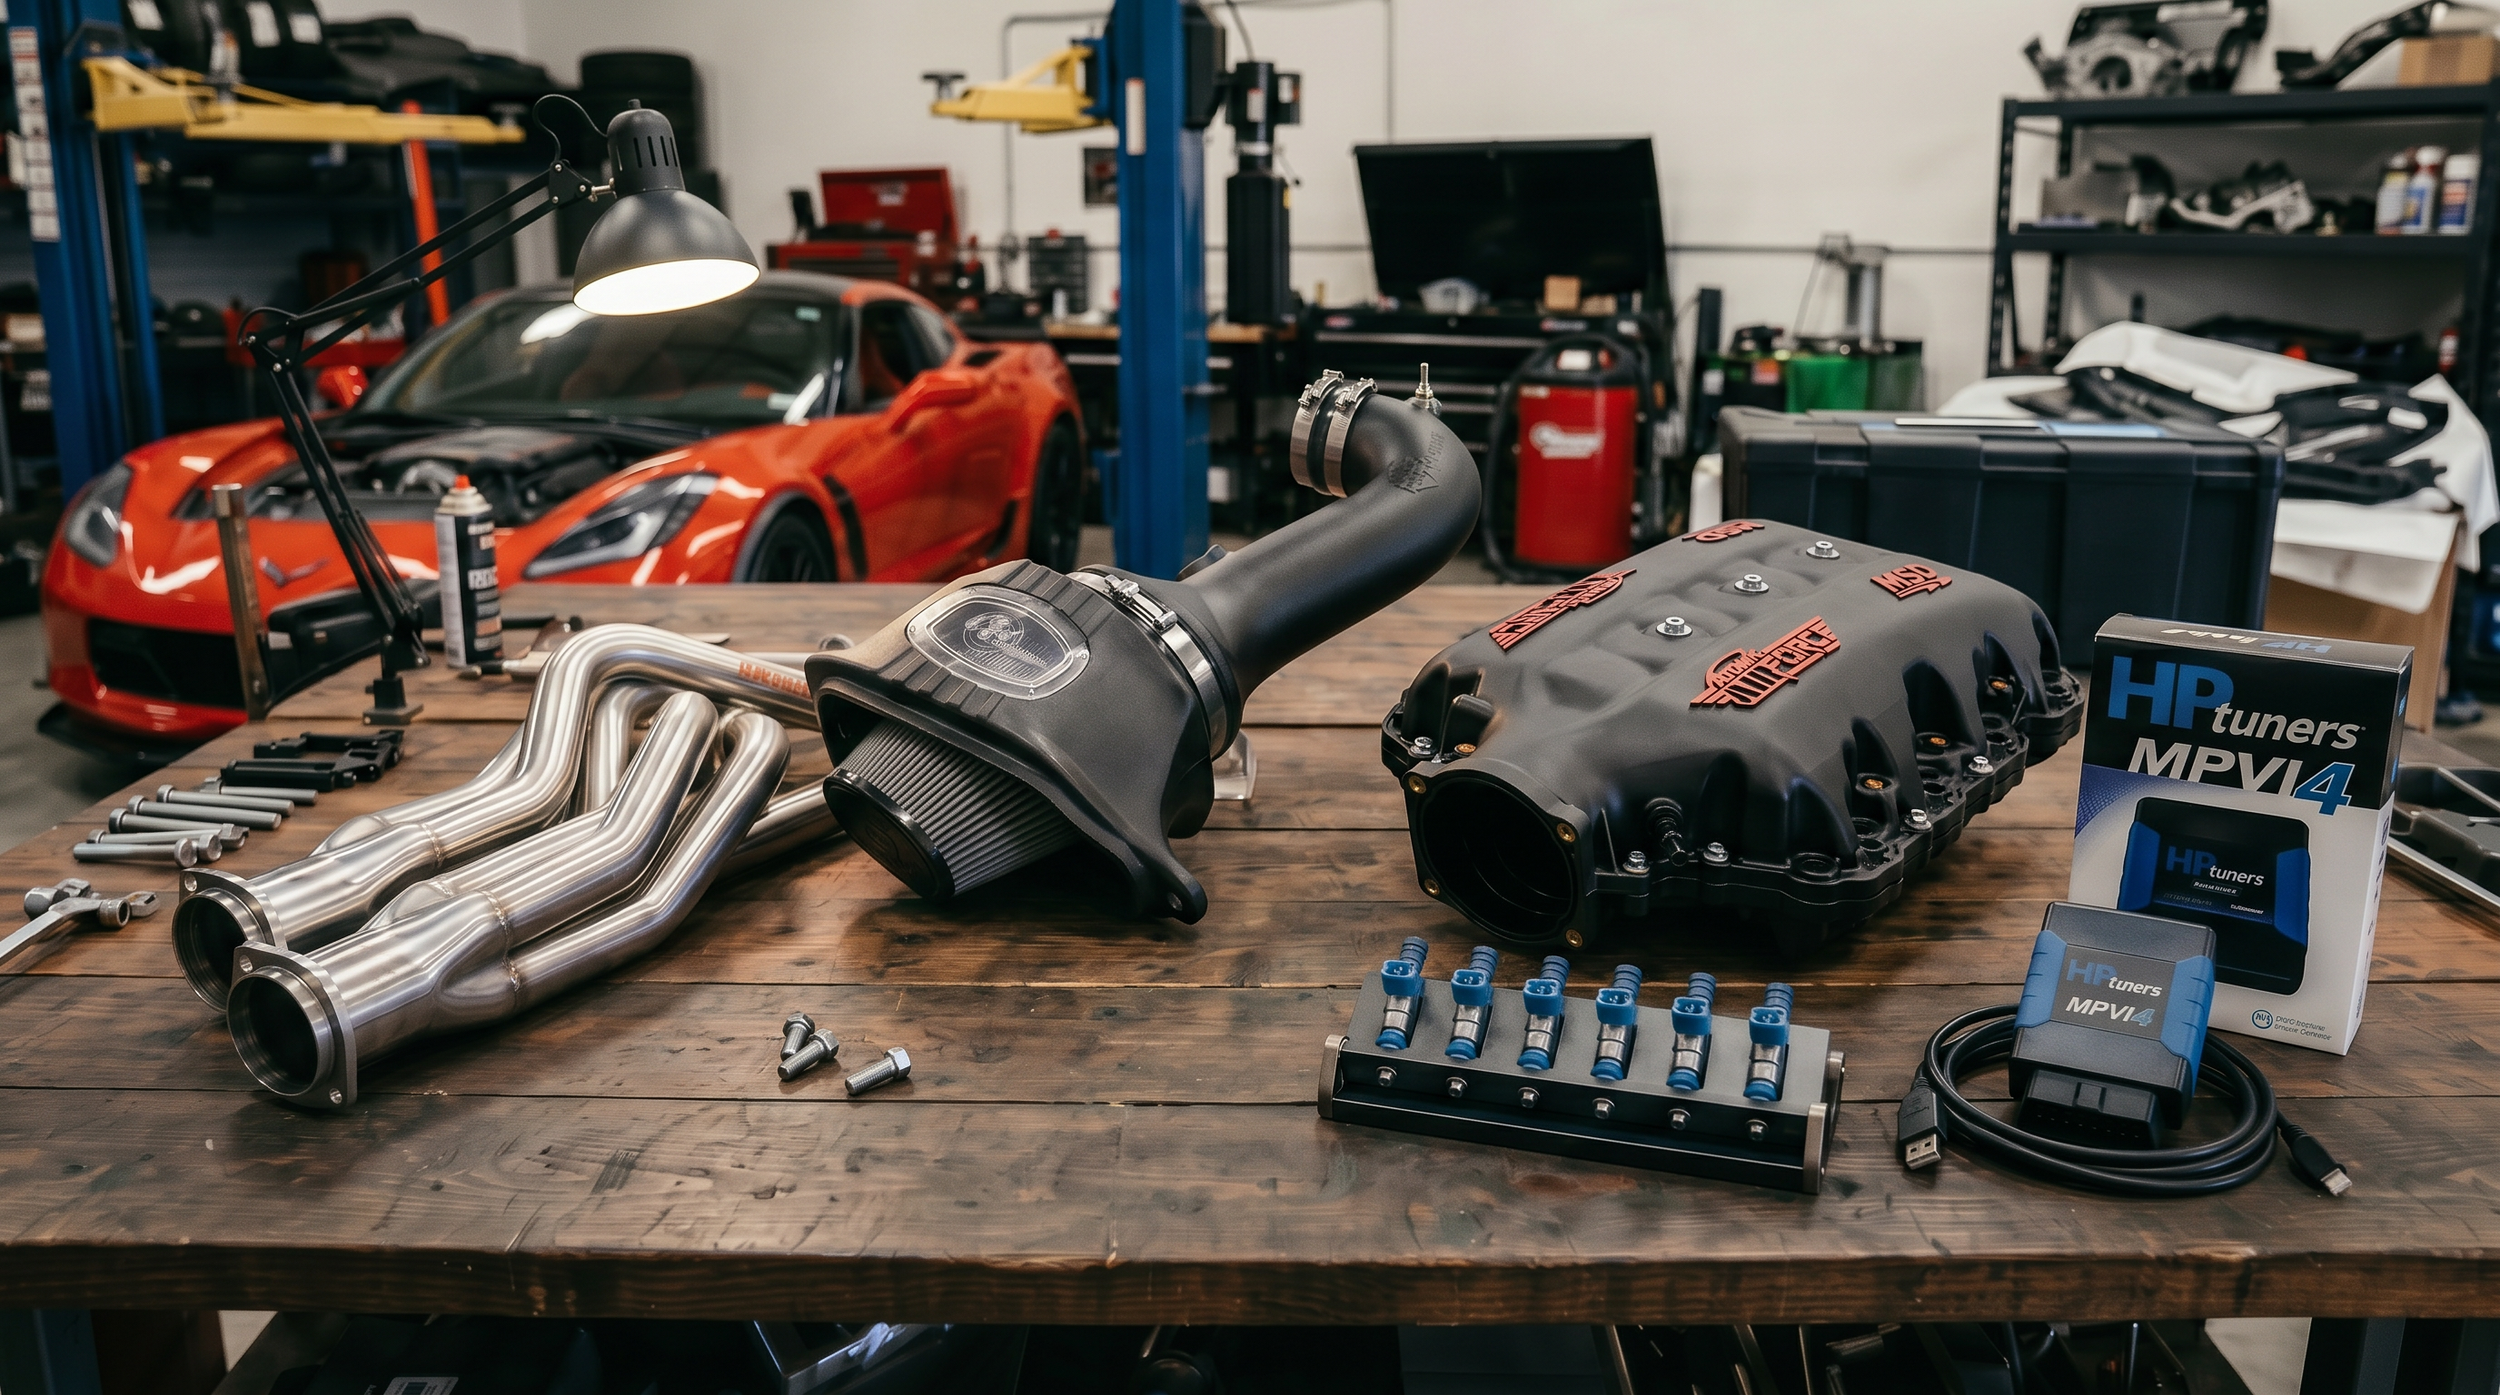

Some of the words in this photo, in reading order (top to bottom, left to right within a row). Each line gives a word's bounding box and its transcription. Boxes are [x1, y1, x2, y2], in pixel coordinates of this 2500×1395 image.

[1870, 564, 1938, 593] MSD
[2108, 655, 2234, 730] HP
[2211, 702, 2360, 750] tuners
[2127, 737, 2356, 816] MPVI4
[2166, 845, 2217, 876] HP
[2209, 865, 2265, 886] tuners
[2066, 959, 2118, 986] HP
[2108, 976, 2162, 997] tuners
[2065, 996, 2156, 1027] MPVI4
